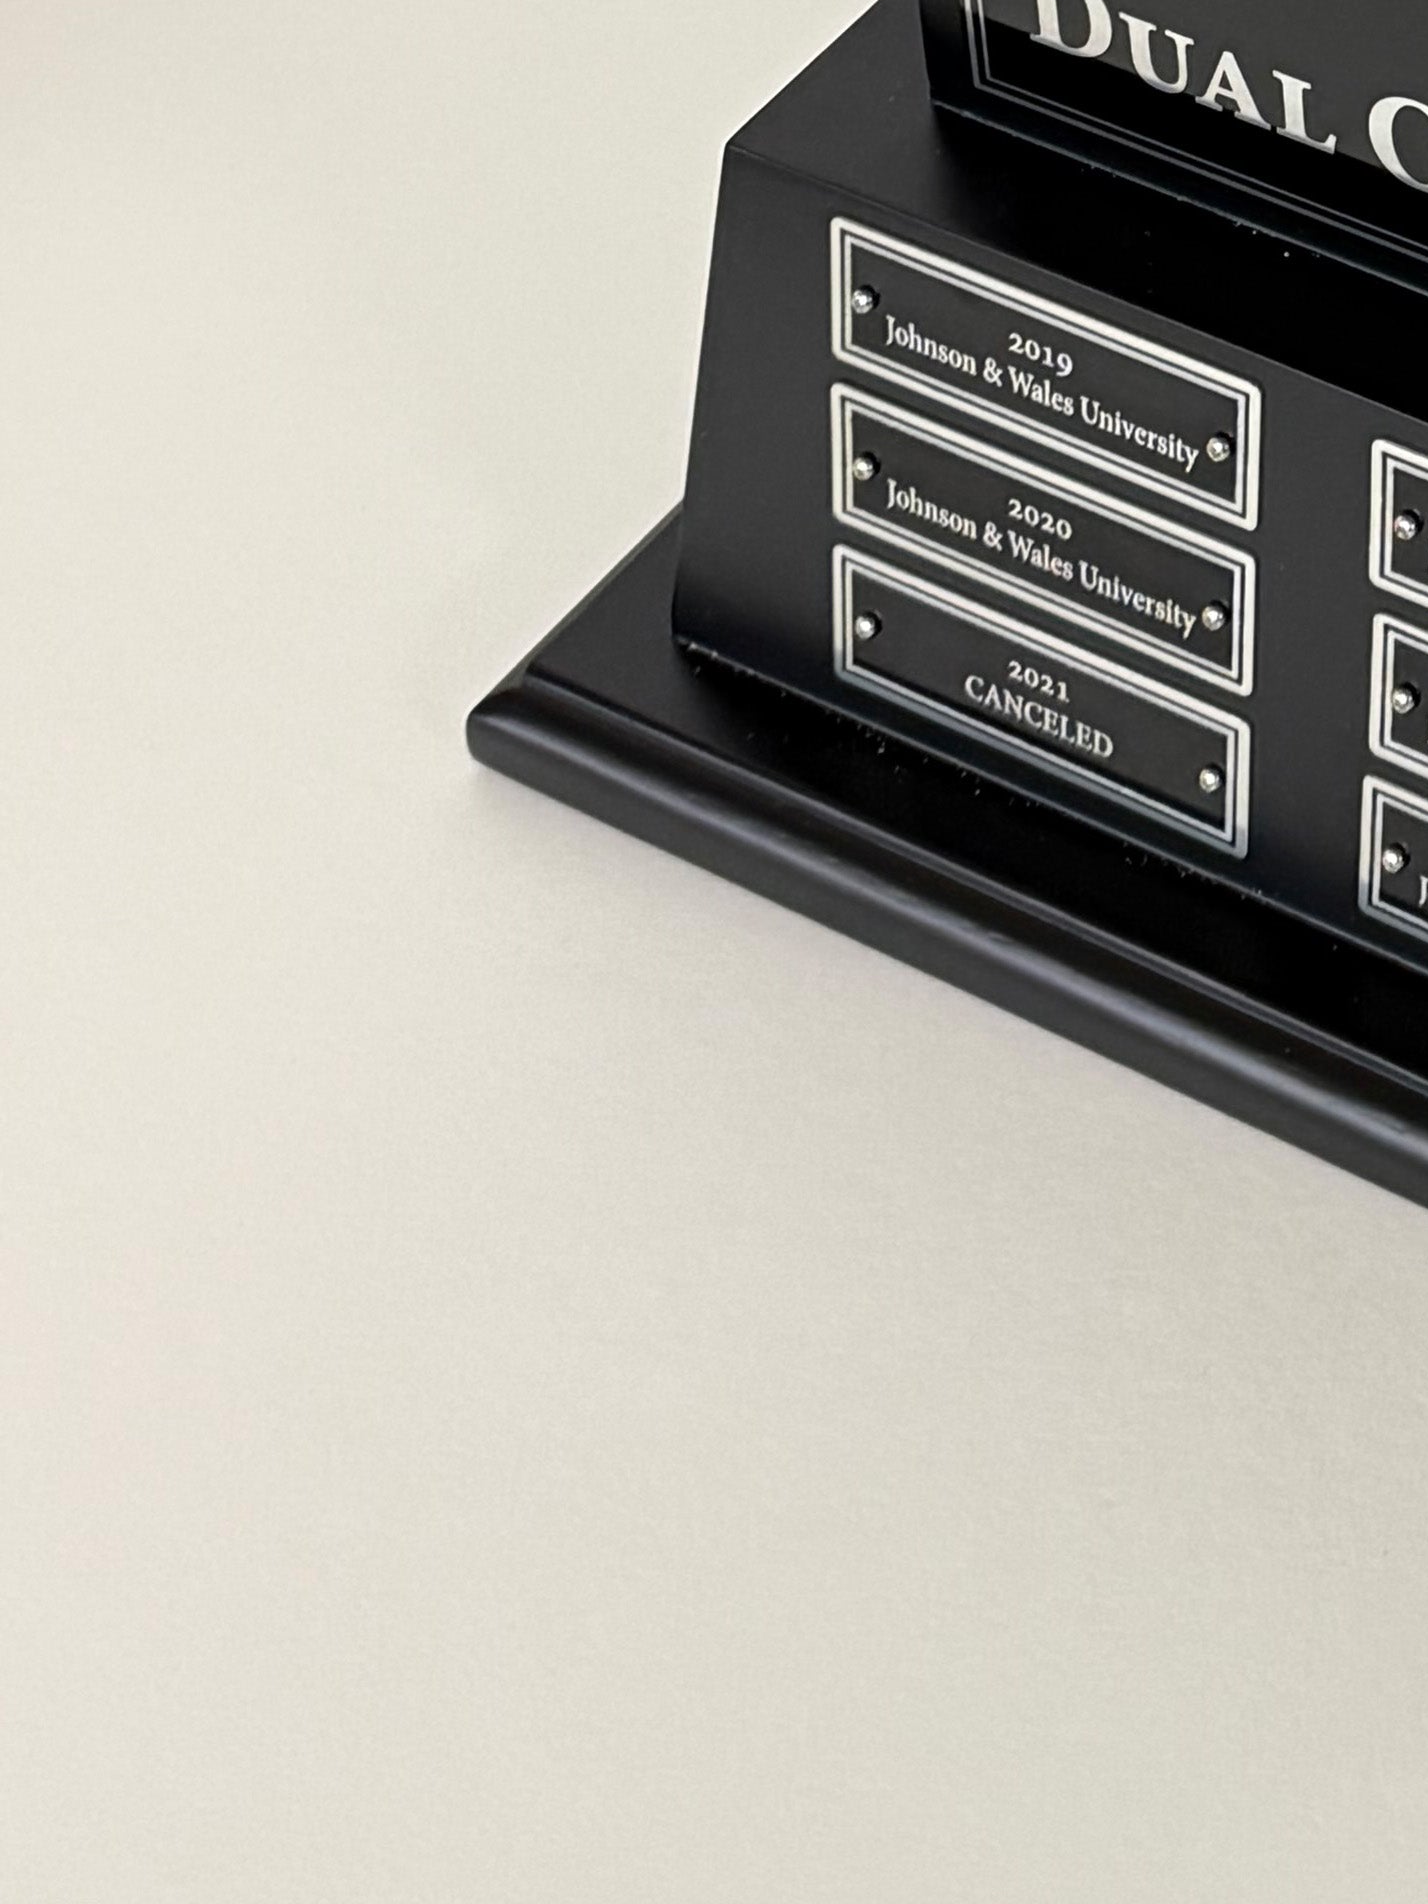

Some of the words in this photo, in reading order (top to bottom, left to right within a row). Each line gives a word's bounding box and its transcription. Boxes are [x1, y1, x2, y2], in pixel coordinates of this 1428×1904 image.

[1007, 331, 1073, 377] 2019
[884, 313, 977, 376] Johnson
[981, 355, 1003, 387] &
[1006, 364, 1074, 416] Wales
[1078, 394, 1200, 473] University
[1007, 497, 1073, 541] 2020
[886, 476, 977, 540] Johnson
[981, 520, 1003, 551] &
[1006, 528, 1074, 581] Wales
[1077, 558, 1197, 639] University
[1007, 659, 1070, 703] 2021
[963, 673, 1114, 758] CANCELED
